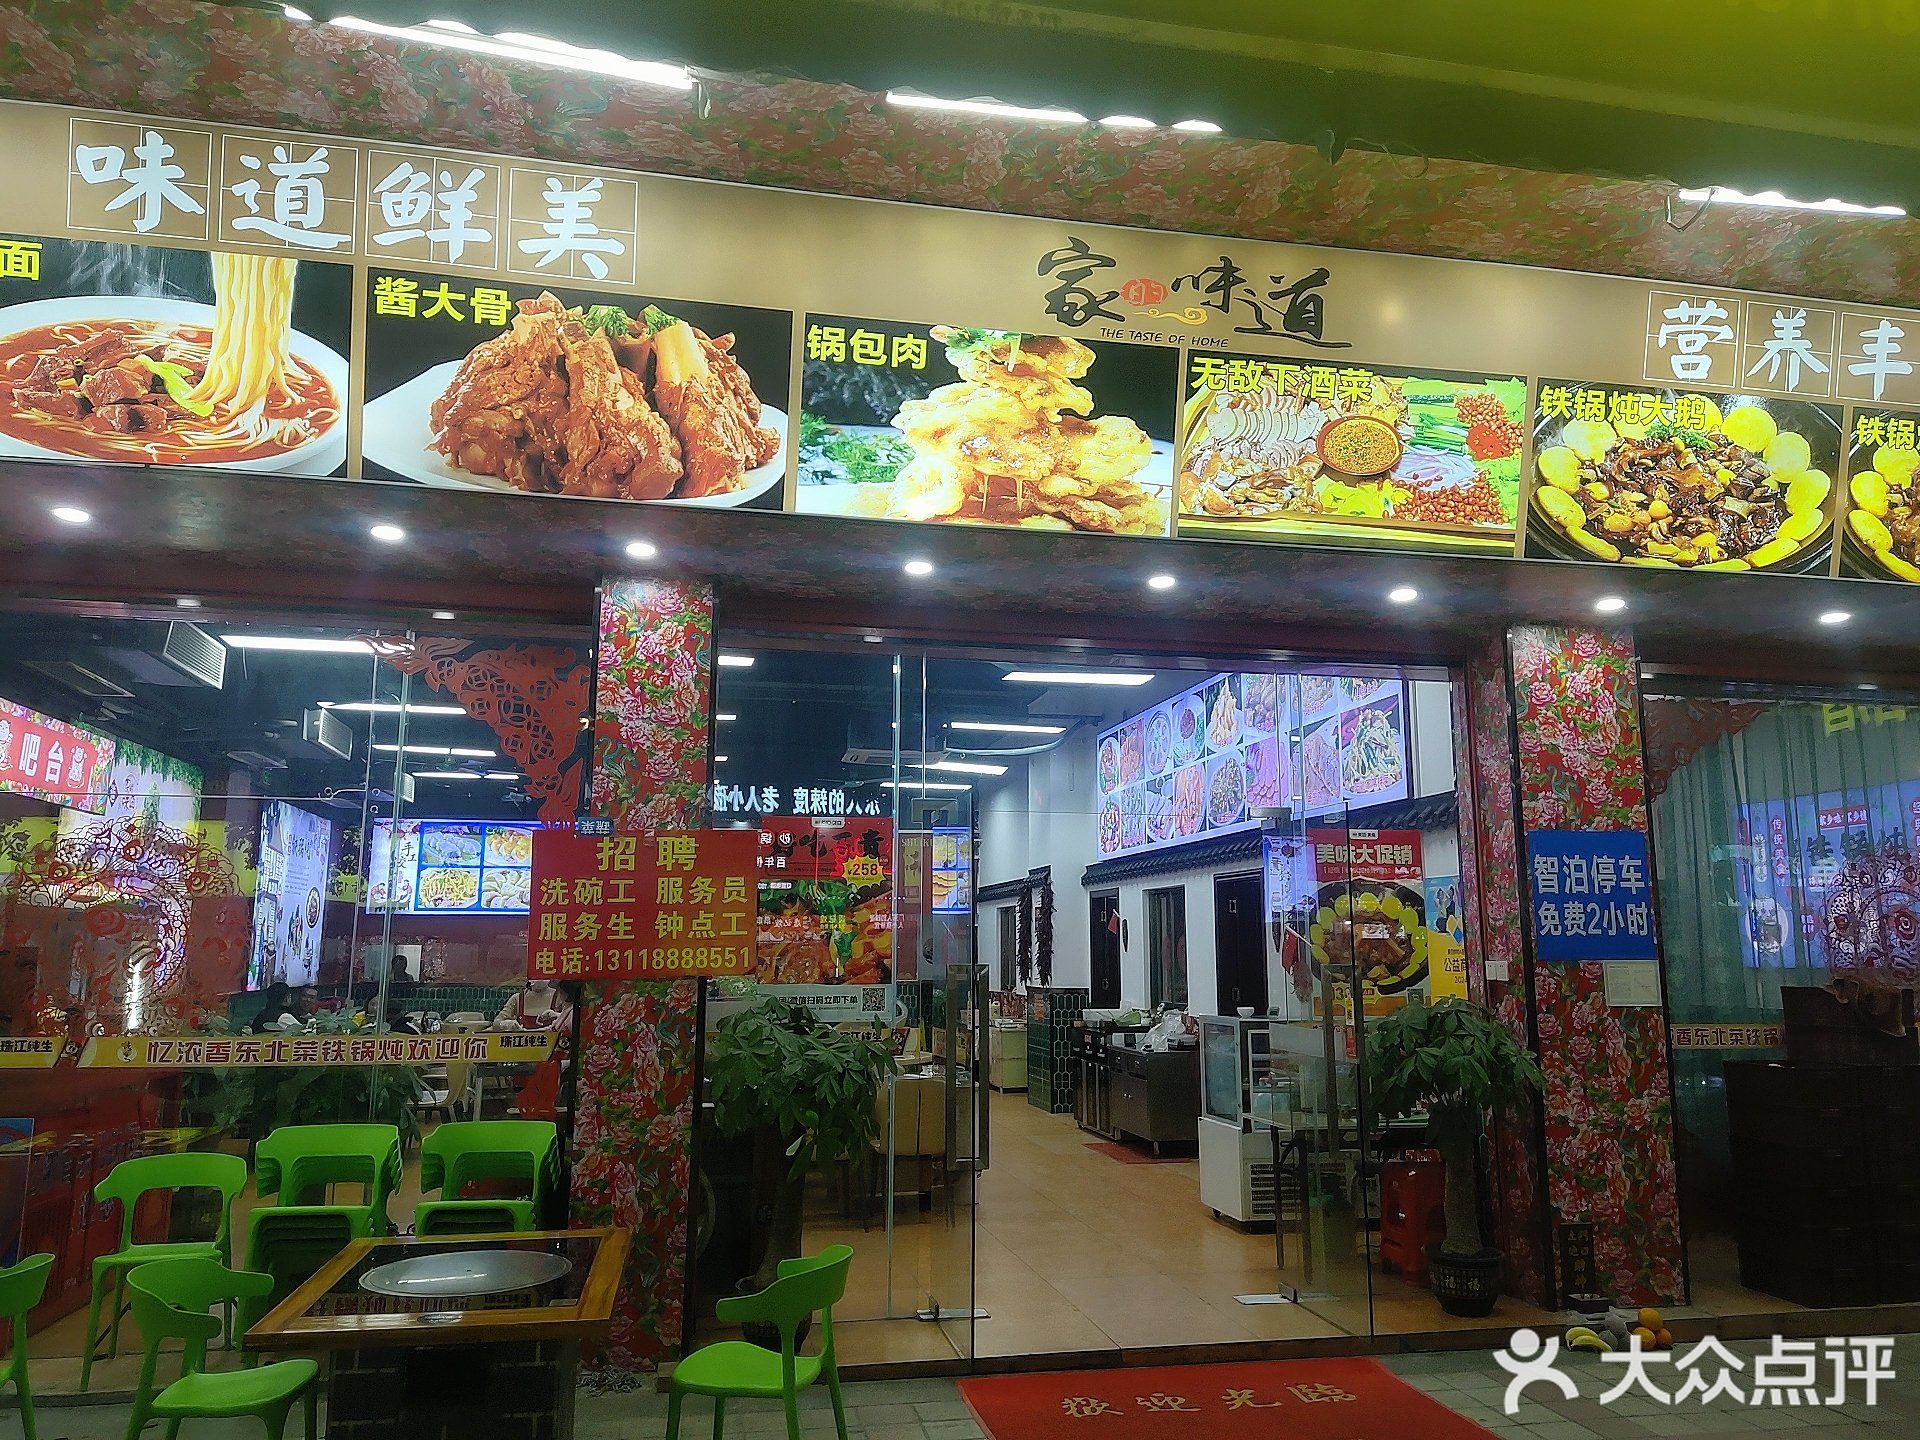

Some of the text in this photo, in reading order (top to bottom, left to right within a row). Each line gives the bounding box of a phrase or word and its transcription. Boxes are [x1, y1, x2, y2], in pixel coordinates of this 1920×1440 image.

[75, 130, 625, 279] 味道鲜美
[0, 240, 43, 281] 面
[373, 275, 511, 327] 酱大骨
[806, 322, 928, 371] 锅包肉
[1099, 327, 1229, 348] THE TASTE OF HOME
[1658, 300, 1914, 401] 营养丰
[1190, 356, 1373, 402] 无敌下酒菜
[1538, 383, 1706, 431] 铁锅炖大鹅
[1855, 414, 1920, 453] 铁锅
[19, 732, 65, 785] 吧台
[581, 821, 610, 835] 蔬菜
[596, 834, 700, 872] 招聘
[1316, 843, 1413, 866] 美味大促销
[540, 876, 748, 906] 洗碗工 服务员
[1534, 853, 1646, 895] 智泊停车
[538, 911, 635, 941] 服务生
[654, 910, 748, 940] 钟点工
[1538, 900, 1649, 937] 免费2小时
[535, 946, 749, 974] 电话:13118888551
[147, 1037, 488, 1064] 忆浓香东北菜铁锅炖欢迎你
